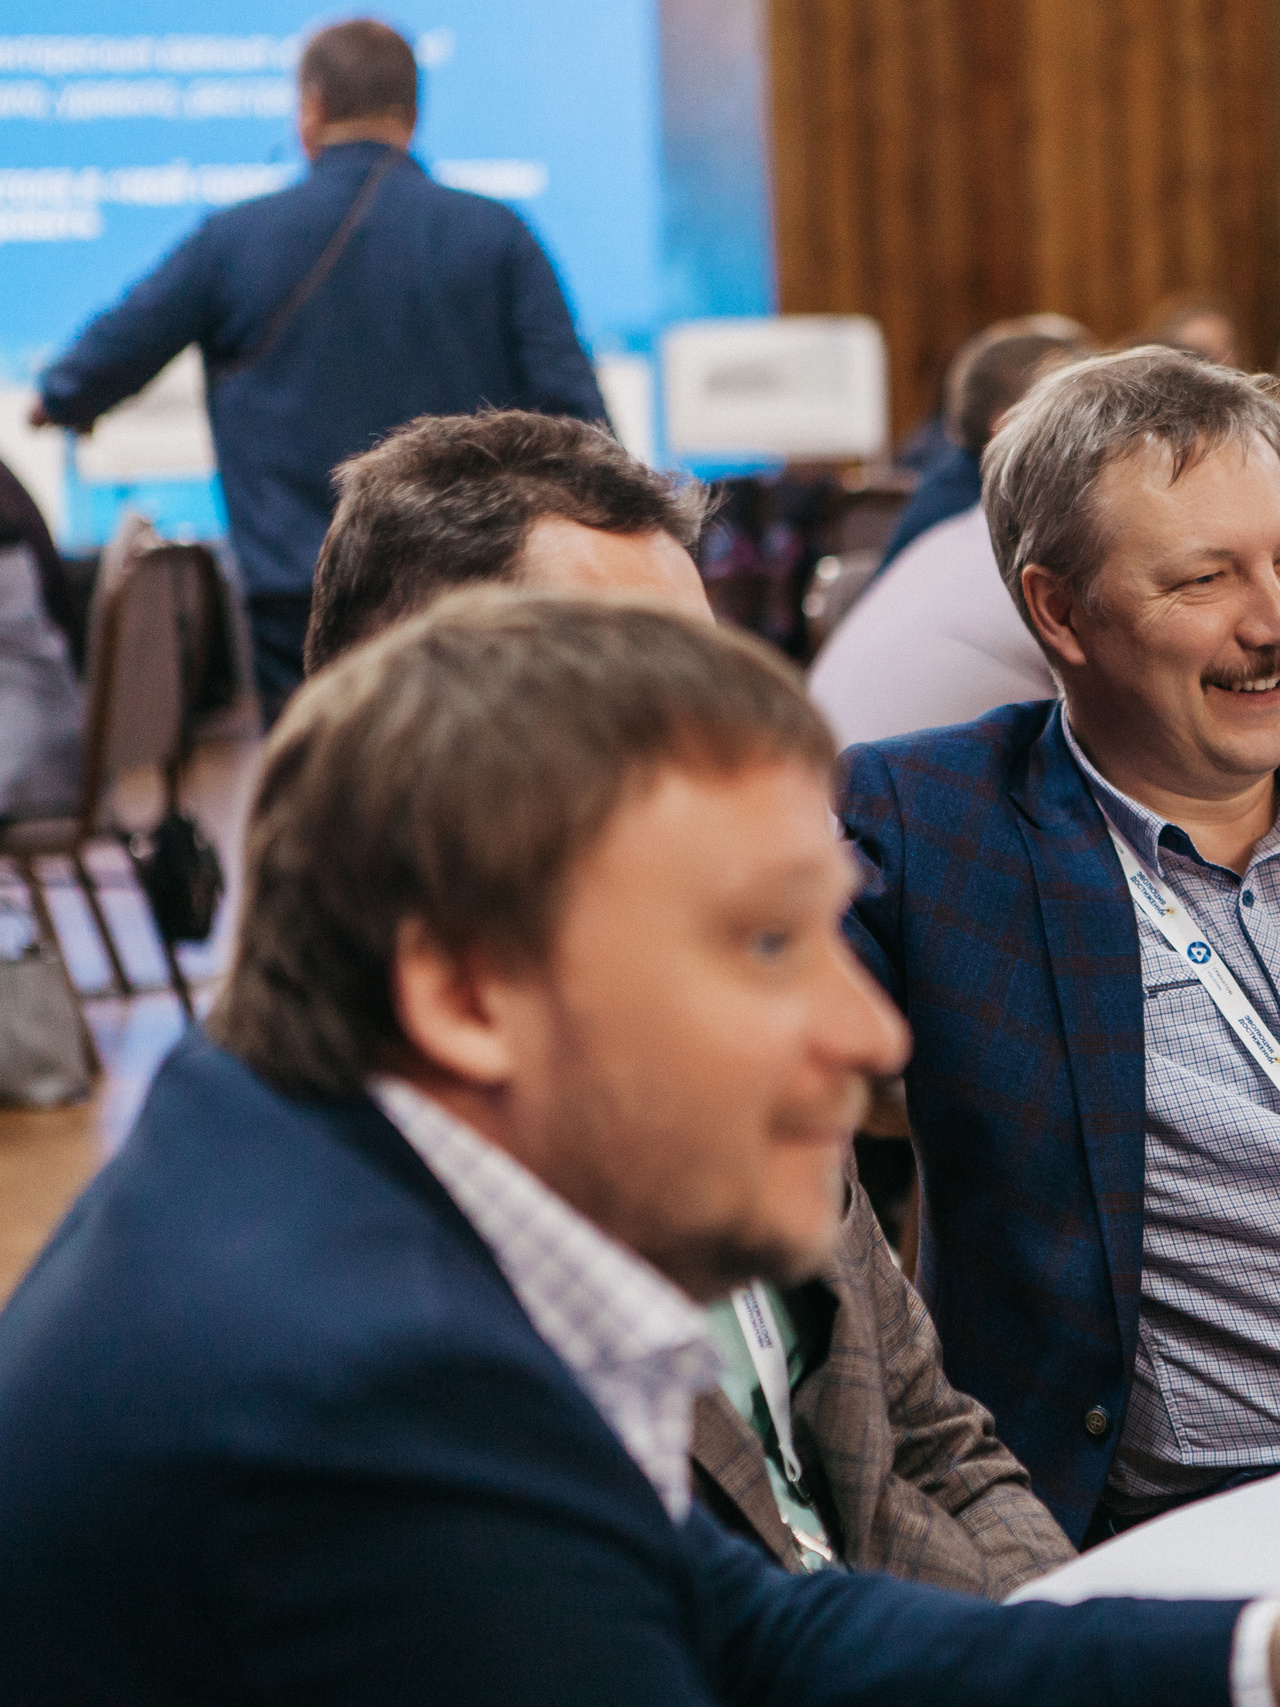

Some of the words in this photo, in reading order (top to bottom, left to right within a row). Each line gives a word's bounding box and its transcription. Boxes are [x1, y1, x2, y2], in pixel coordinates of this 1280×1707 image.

[1136, 870, 1167, 906] ЭВОЛЮЦИЯ
[1213, 967, 1234, 995] ГРИНАТОМ
[1244, 1015, 1275, 1054] ЭВОЛЮЦИЯ
